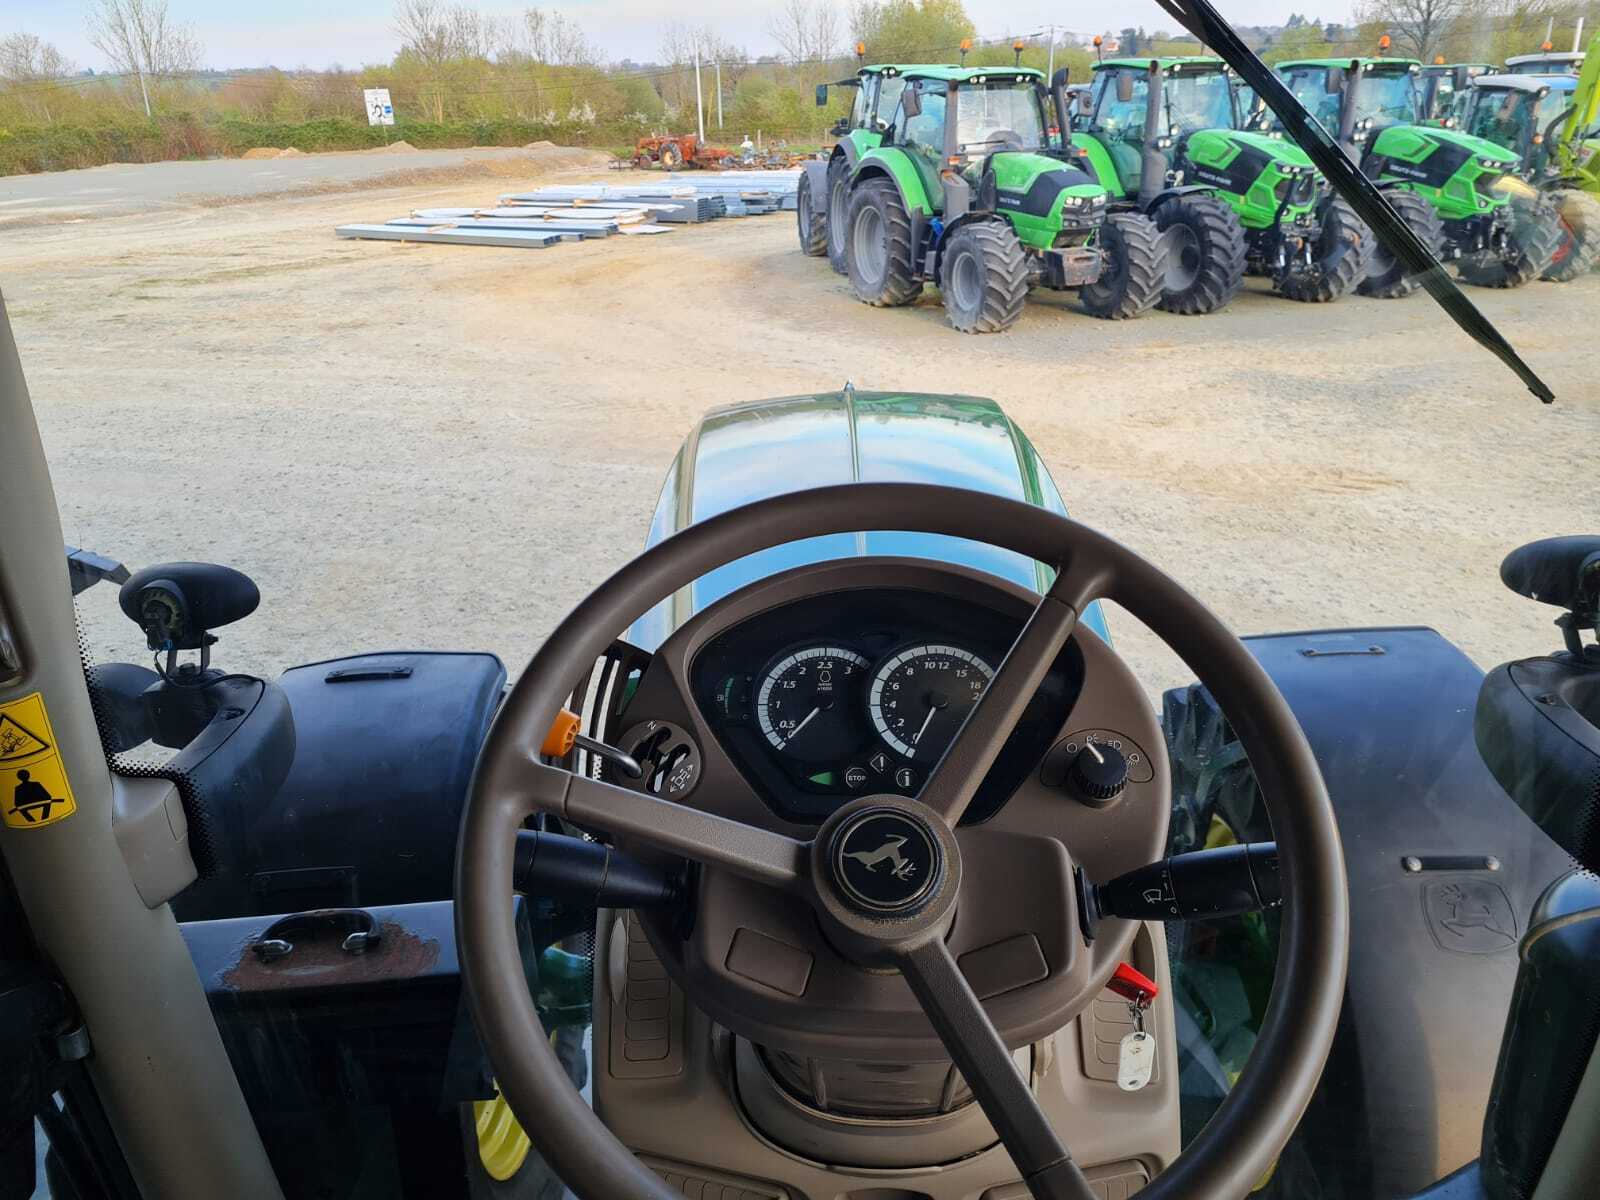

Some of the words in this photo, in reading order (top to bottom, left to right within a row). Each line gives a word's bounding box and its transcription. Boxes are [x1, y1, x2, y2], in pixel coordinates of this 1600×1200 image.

[844, 666, 852, 674] 3
[938, 662, 950, 670] 12
[906, 668, 914, 676] 8
[956, 670, 968, 678] 15
[784, 680, 796, 688] 1.5
[890, 700, 896, 708] 4
[780, 720, 796, 728] 0.5
[897, 718, 904, 726] 2
